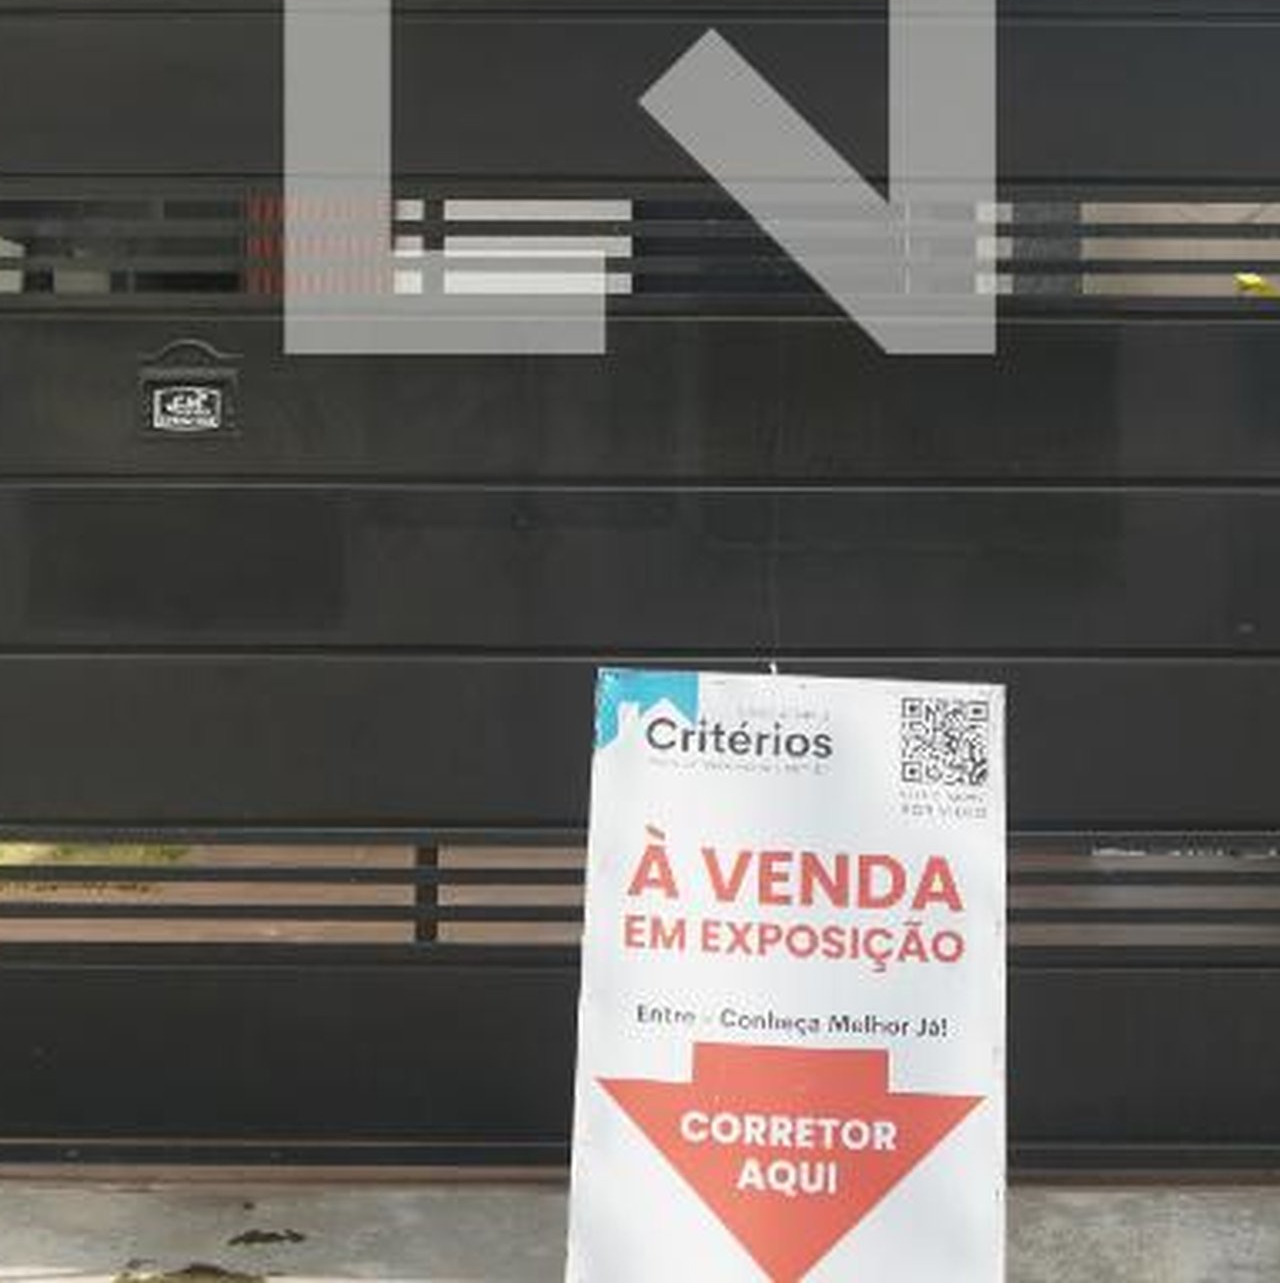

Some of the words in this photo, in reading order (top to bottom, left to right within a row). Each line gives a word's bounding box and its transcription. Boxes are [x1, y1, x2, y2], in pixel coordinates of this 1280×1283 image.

[646, 717, 834, 758] Critérios
[627, 825, 679, 899] À
[700, 847, 965, 912] VENDA
[624, 915, 686, 952] EM
[700, 920, 966, 972] EXPOSIÇÃO
[828, 1014, 909, 1037] Melhor
[916, 1017, 948, 1038] Já!
[680, 1111, 898, 1151] CORRETOR
[737, 1161, 838, 1196] AQUI
